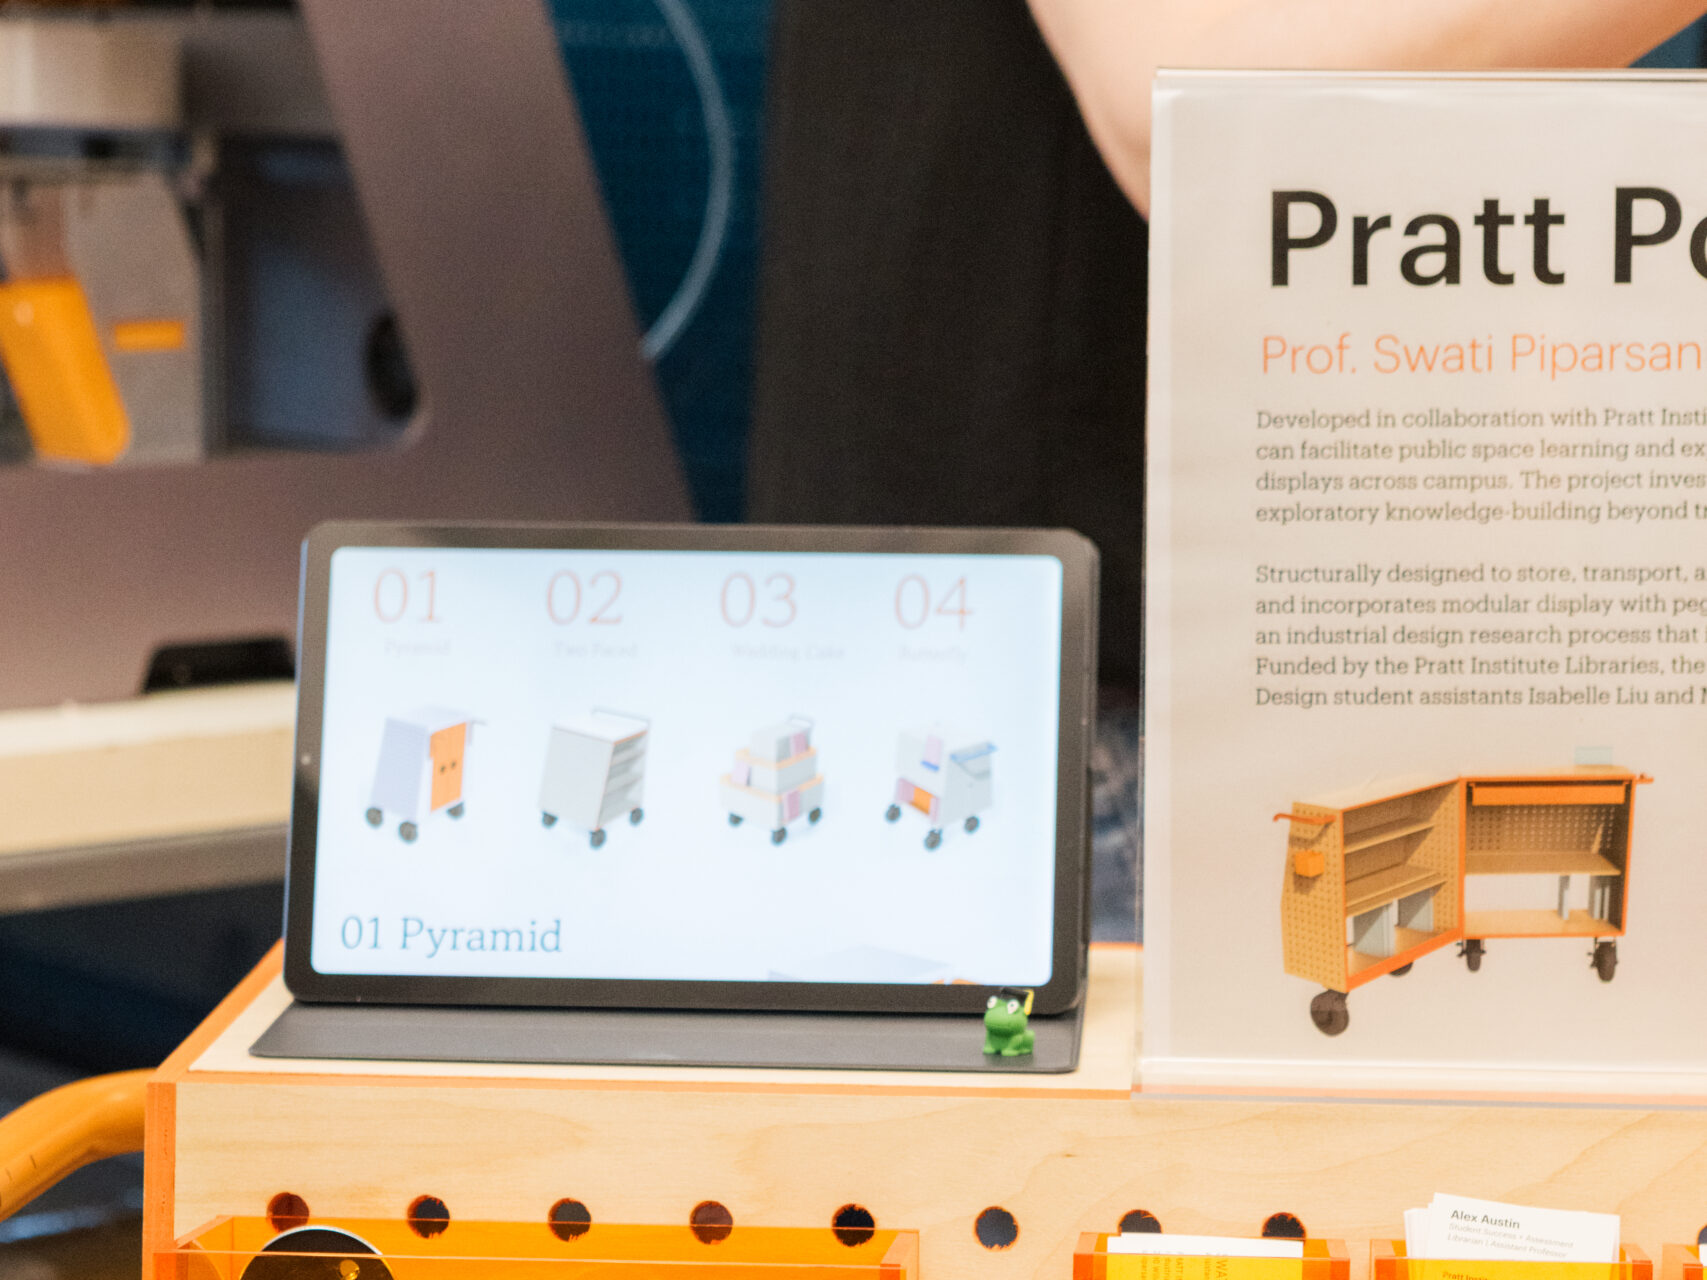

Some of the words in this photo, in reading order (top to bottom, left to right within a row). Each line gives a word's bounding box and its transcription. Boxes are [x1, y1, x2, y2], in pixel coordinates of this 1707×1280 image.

[1272, 190, 1565, 287] Pratt
[1614, 187, 1707, 284] P
[1262, 333, 1357, 375] Prof.
[1373, 333, 1494, 374] Swati
[1511, 333, 1702, 380] Piparsan
[1256, 409, 1370, 432] Developed
[1377, 409, 1396, 428] in
[1402, 408, 1544, 428] collaboration
[1550, 408, 1596, 427] with
[1604, 408, 1654, 427] Pratt
[1256, 445, 1294, 459] can
[1300, 440, 1392, 460] facilitate
[1399, 439, 1466, 462] public
[1472, 443, 1534, 462] space
[1540, 439, 1628, 461] learning
[1635, 439, 1674, 457] and
[1256, 471, 1343, 494] displays
[1349, 475, 1417, 490] across
[1422, 474, 1514, 493] campus.
[1520, 470, 1561, 489] The
[1567, 470, 1642, 493] project
[1649, 468, 1705, 488] inves
[1256, 502, 1379, 525] exploratory
[1385, 501, 1600, 525] knowledge-building
[1607, 499, 1688, 524] beyond
[1255, 564, 1382, 587] Structurally
[1387, 563, 1484, 587] designed
[1491, 567, 1511, 583] to
[1517, 567, 1576, 585] store,
[1583, 565, 1688, 587] transport,
[373, 568, 441, 625] 01
[546, 570, 624, 627] 02
[718, 572, 798, 630] 03
[894, 574, 973, 633] 04
[1256, 596, 1295, 615] and
[1301, 594, 1436, 617] incorporates
[1442, 594, 1529, 614] modular
[1536, 594, 1612, 617] display
[1620, 592, 1666, 613] with
[384, 637, 451, 658] Pyramid
[1256, 628, 1280, 645] an
[1287, 625, 1387, 645] industrial
[1392, 625, 1463, 648] design
[1469, 624, 1562, 645] research
[1568, 627, 1652, 648] process
[1657, 623, 1698, 644] that
[1256, 656, 1336, 676] Funded
[1342, 656, 1368, 679] by
[1375, 656, 1408, 675] the
[1414, 656, 1464, 675] Pratt
[1471, 656, 1559, 675] Institute
[1565, 655, 1665, 677] Libraries,
[1671, 655, 1704, 673] the
[1256, 687, 1328, 709] Design
[1334, 687, 1413, 706] student
[1419, 687, 1523, 706] assistants
[1528, 686, 1611, 706] Isabelle
[1617, 686, 1648, 705] Liu
[1654, 686, 1693, 704] and
[340, 916, 382, 951] 01
[399, 916, 563, 960] Pyramid
[1449, 1223, 1481, 1234] Student
[1483, 1228, 1517, 1240] Success
[1451, 1210, 1477, 1223] Alex
[1481, 1214, 1520, 1229] Austin
[1448, 1234, 1484, 1247] Librarian
[1490, 1240, 1527, 1253] Assistant
[1529, 1246, 1567, 1258] Professor
[1442, 1271, 1465, 1280] Pratt
